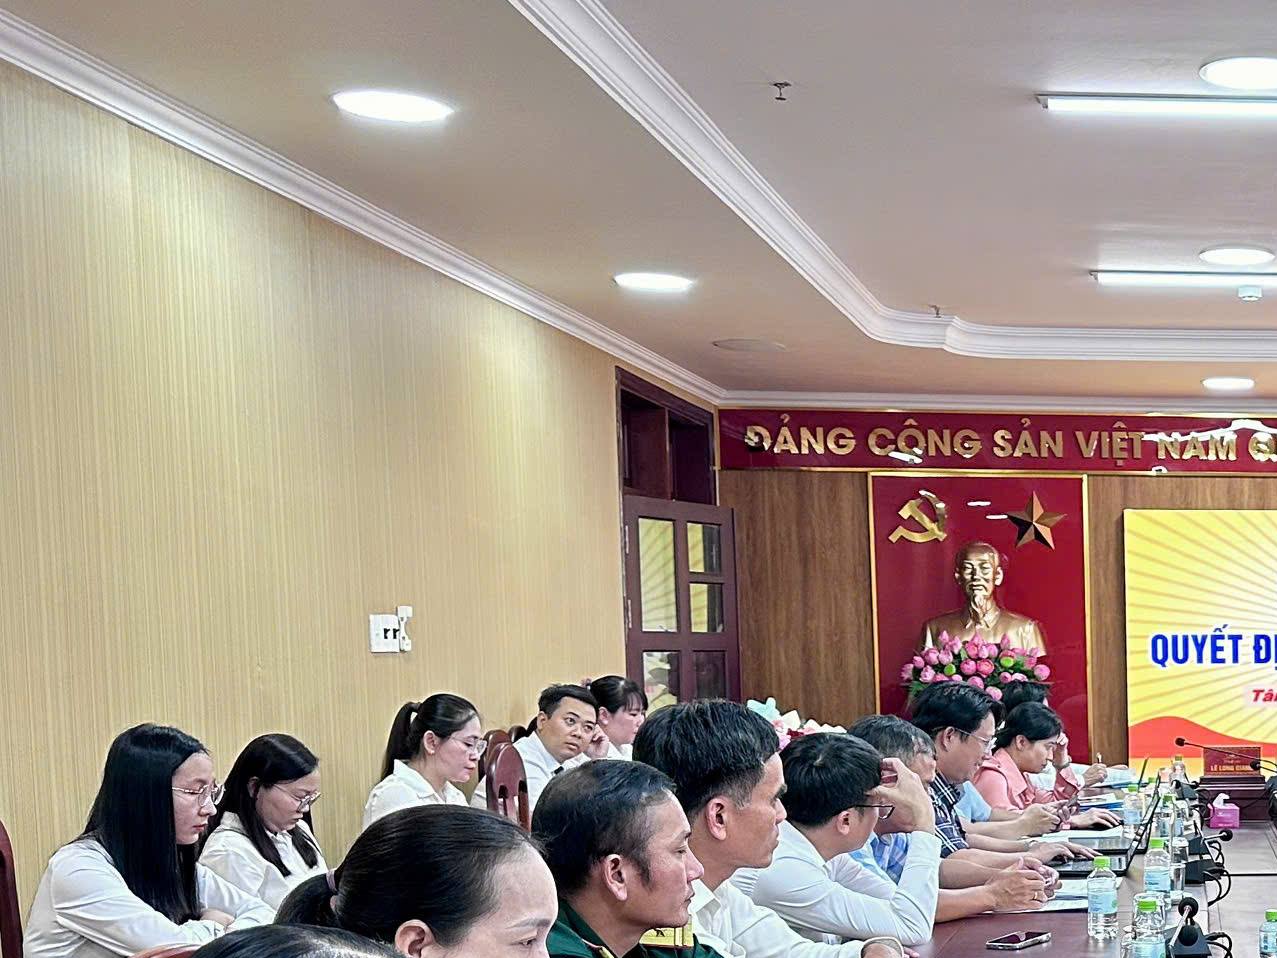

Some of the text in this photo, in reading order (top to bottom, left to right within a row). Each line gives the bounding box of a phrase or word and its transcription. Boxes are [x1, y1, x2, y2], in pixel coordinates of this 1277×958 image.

[744, 414, 857, 456] ĐẢNG
[868, 418, 982, 458] CÔNG
[993, 418, 1064, 458] SẢN
[1074, 421, 1144, 466] VIỆT
[1156, 430, 1238, 461] NAM
[1150, 623, 1243, 667] QUYẾT
